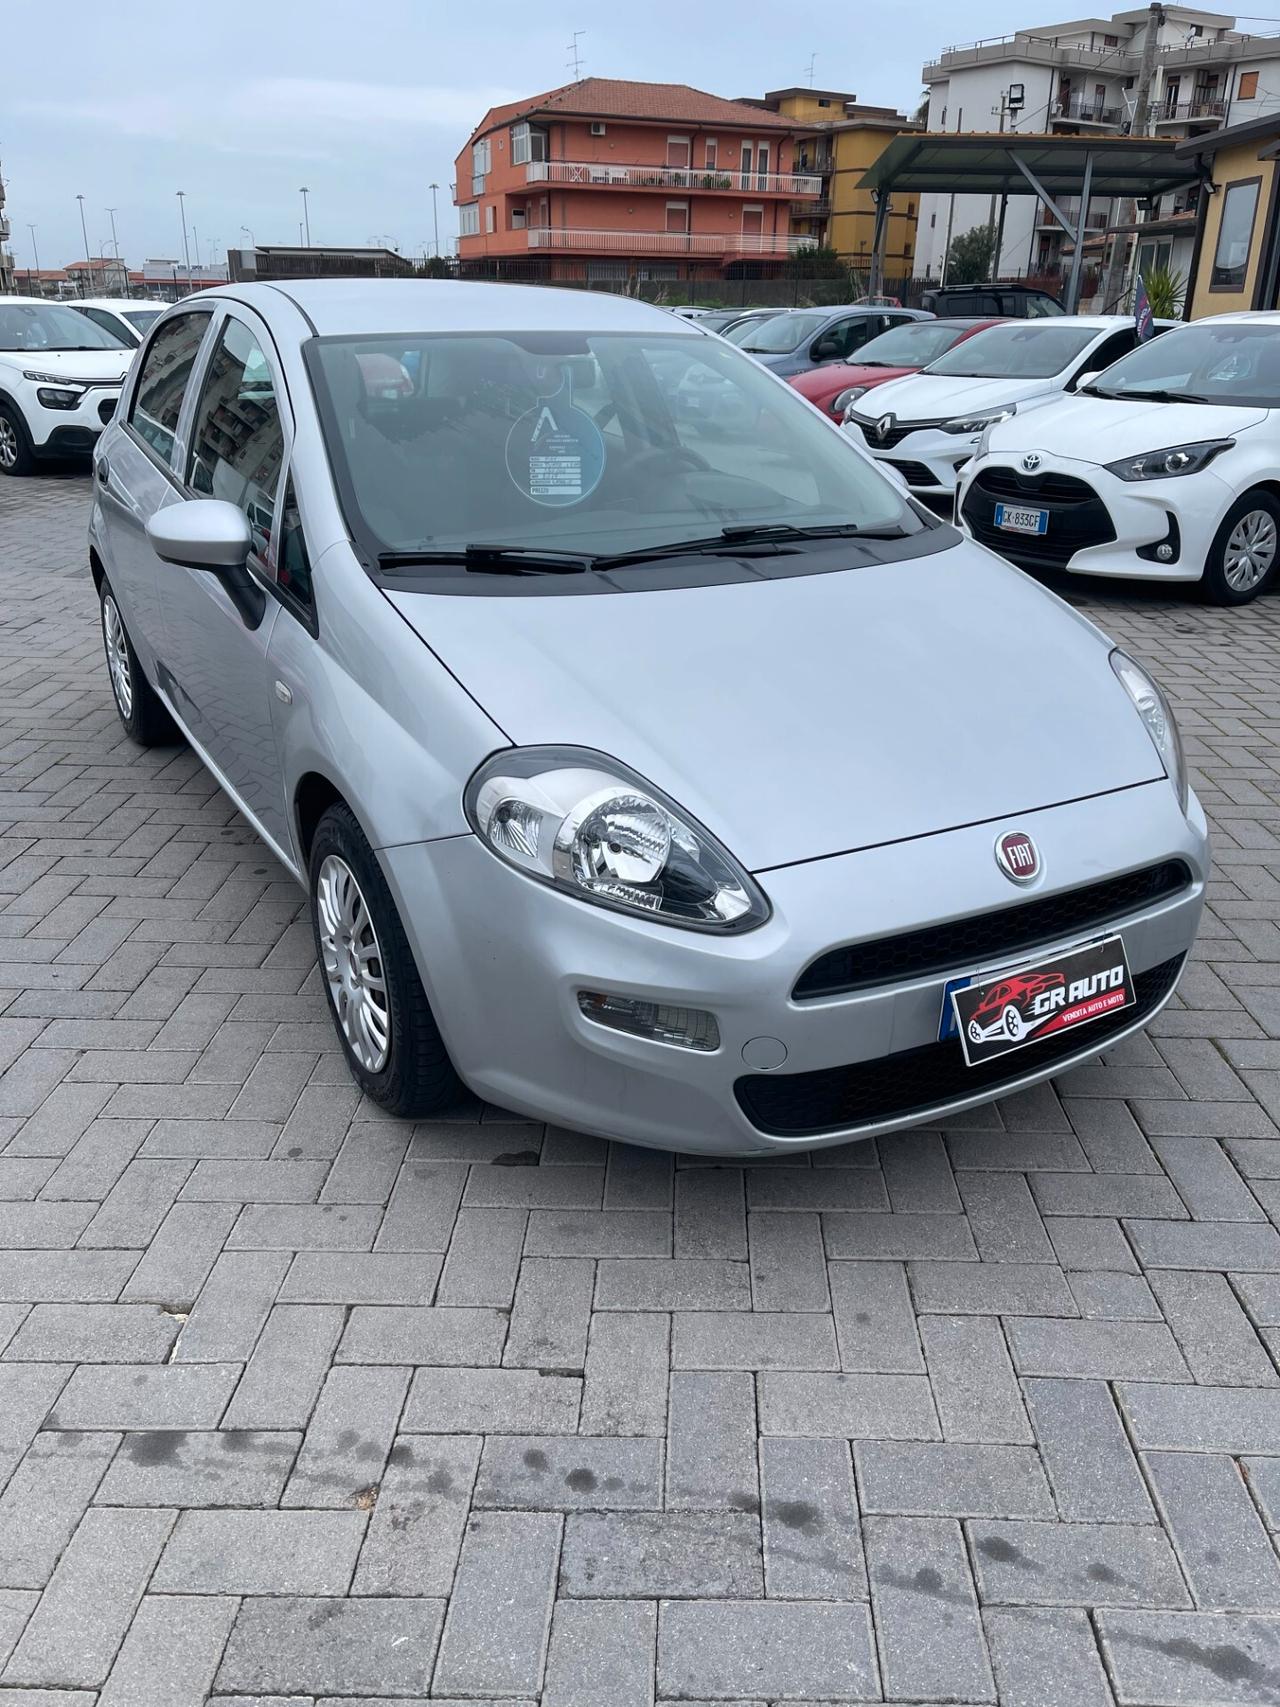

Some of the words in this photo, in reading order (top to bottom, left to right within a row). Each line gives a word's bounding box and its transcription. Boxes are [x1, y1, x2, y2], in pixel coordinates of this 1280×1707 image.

[1007, 843, 1034, 869] FIAT
[1033, 986, 1066, 1015] GR
[1069, 965, 1124, 1003] AUTO
[1062, 1007, 1087, 1022] VENDITA
[1087, 1000, 1103, 1013] AUTO
[1103, 999, 1108, 1008] E
[1108, 994, 1124, 1006] MOTO
